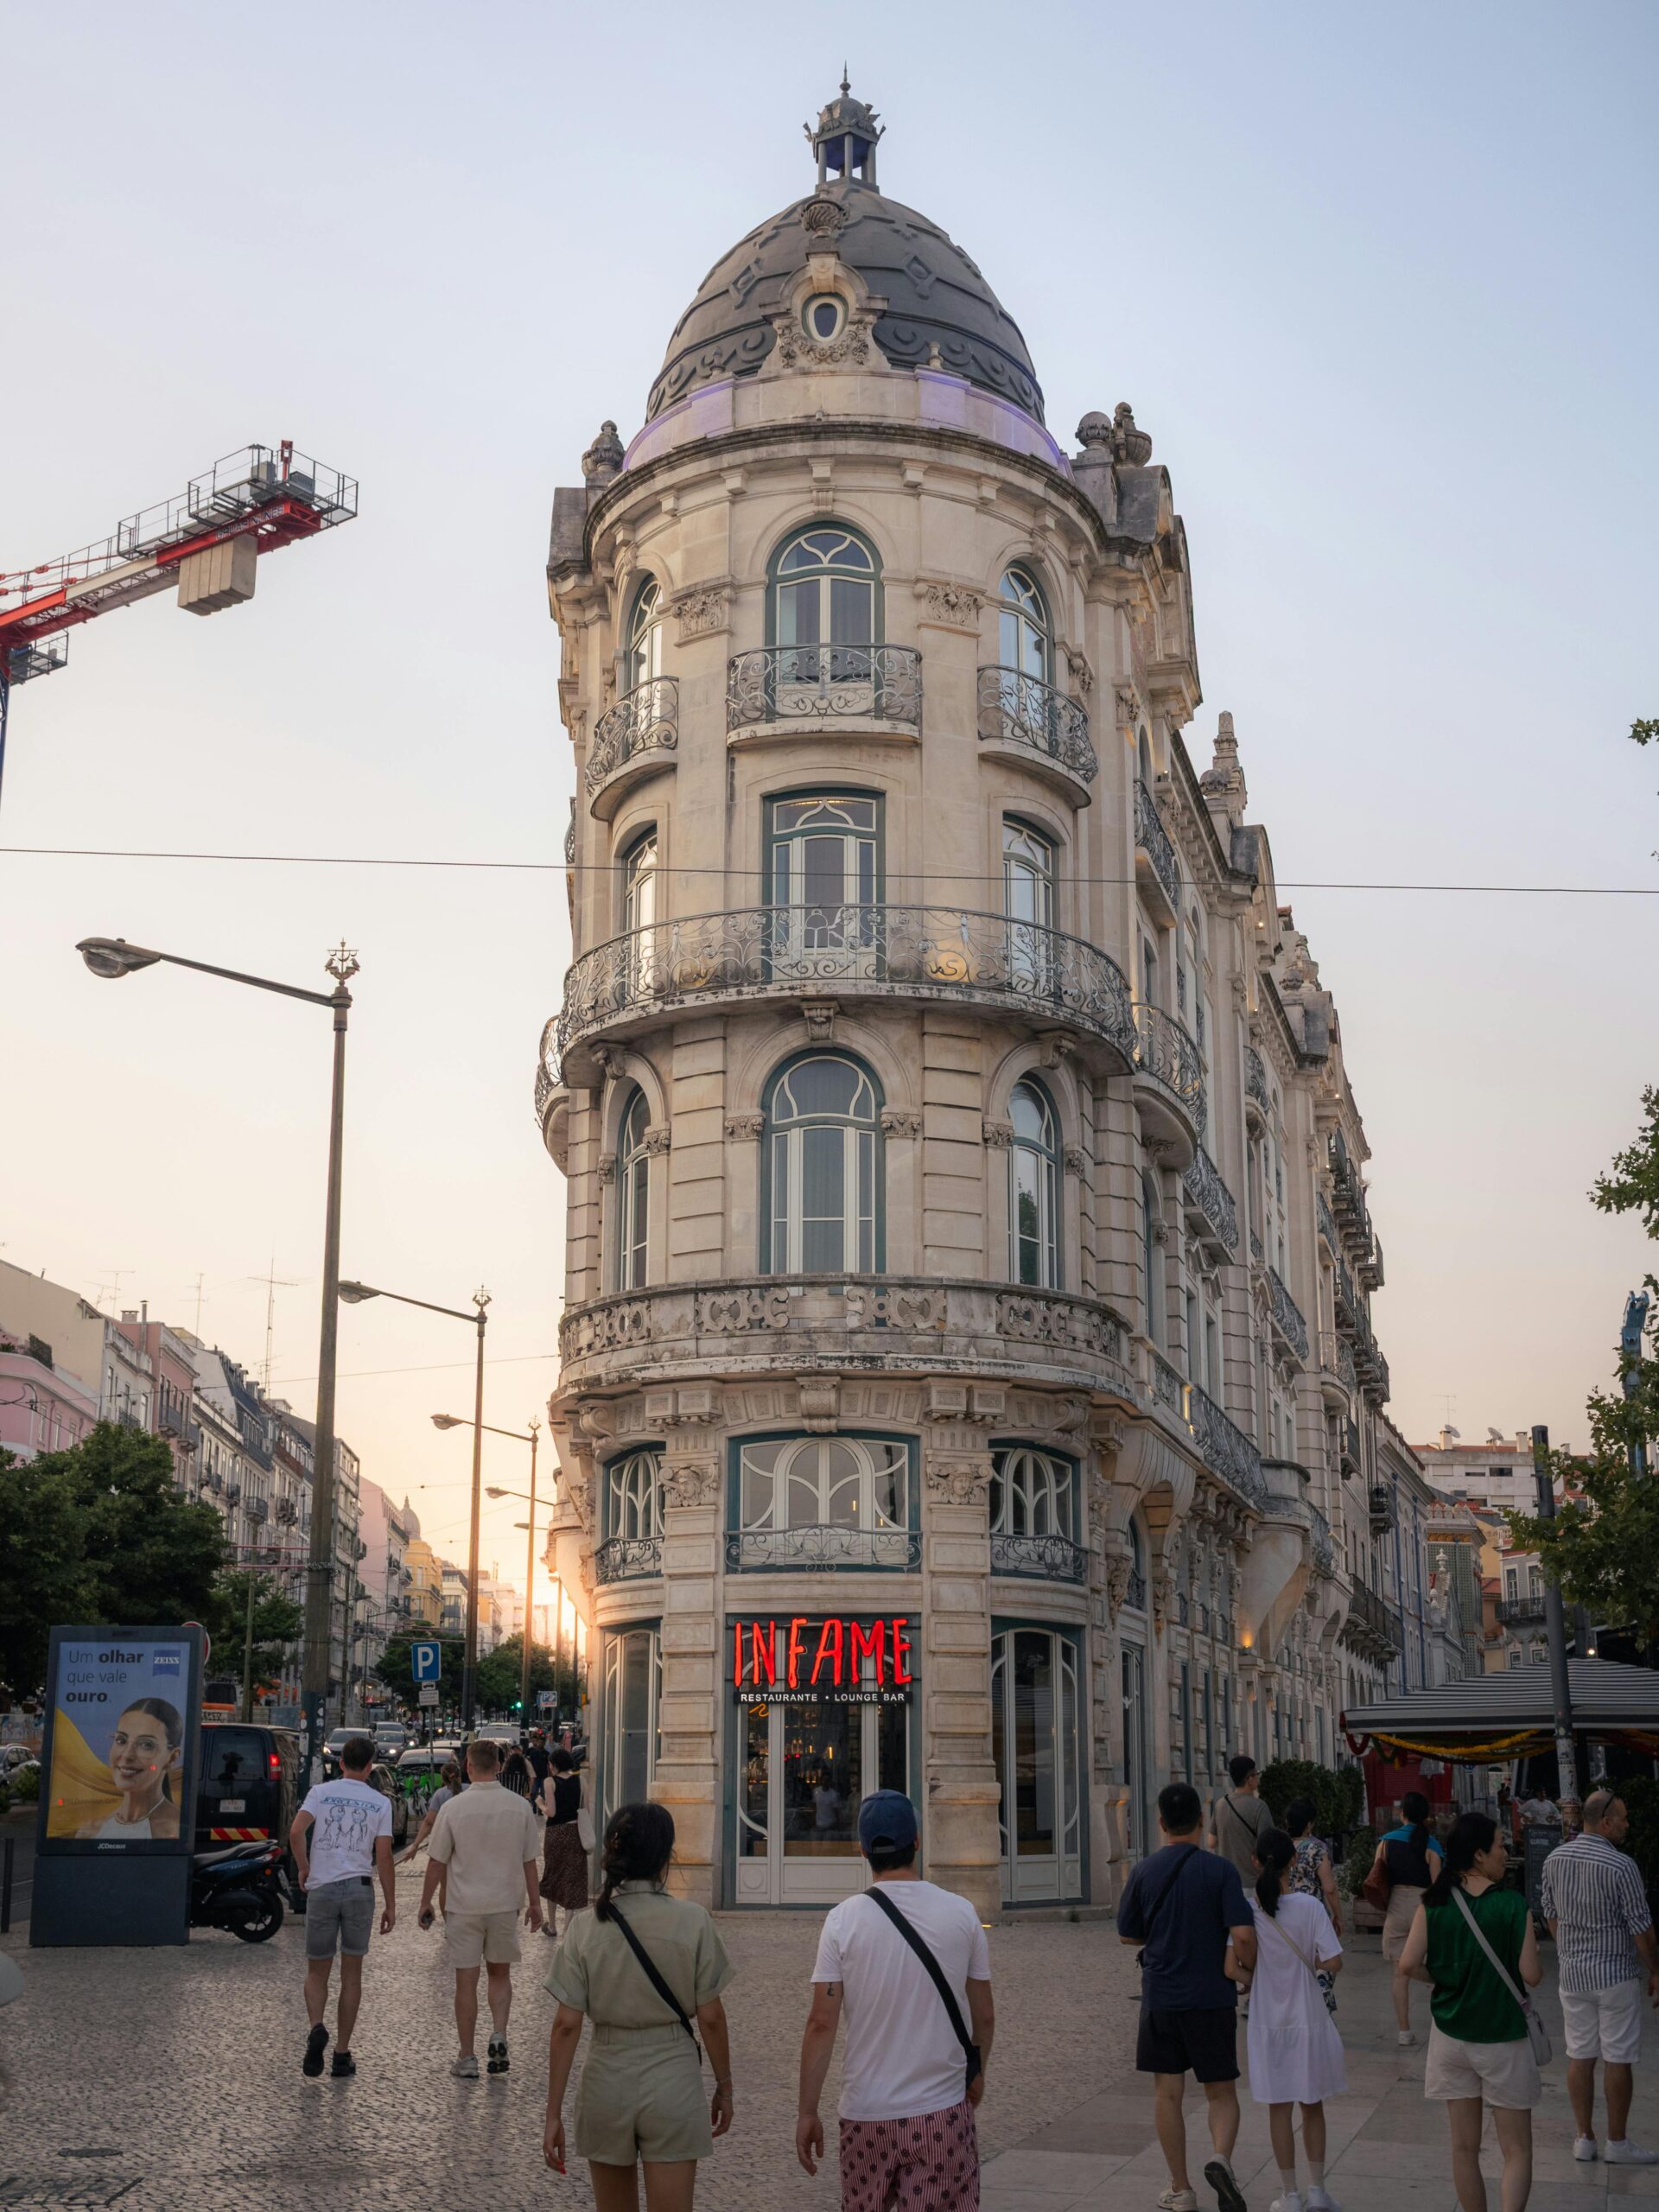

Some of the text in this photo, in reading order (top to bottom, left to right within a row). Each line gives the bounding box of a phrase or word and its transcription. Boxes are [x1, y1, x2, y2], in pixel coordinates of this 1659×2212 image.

[69, 1649, 144, 1664] Um olhar
[734, 1618, 912, 1689] INFAME
[417, 1646, 434, 1678] P
[67, 1669, 127, 1685] que vale
[66, 1691, 111, 1703] ouro.
[741, 1694, 817, 1702] RESTAURANTE
